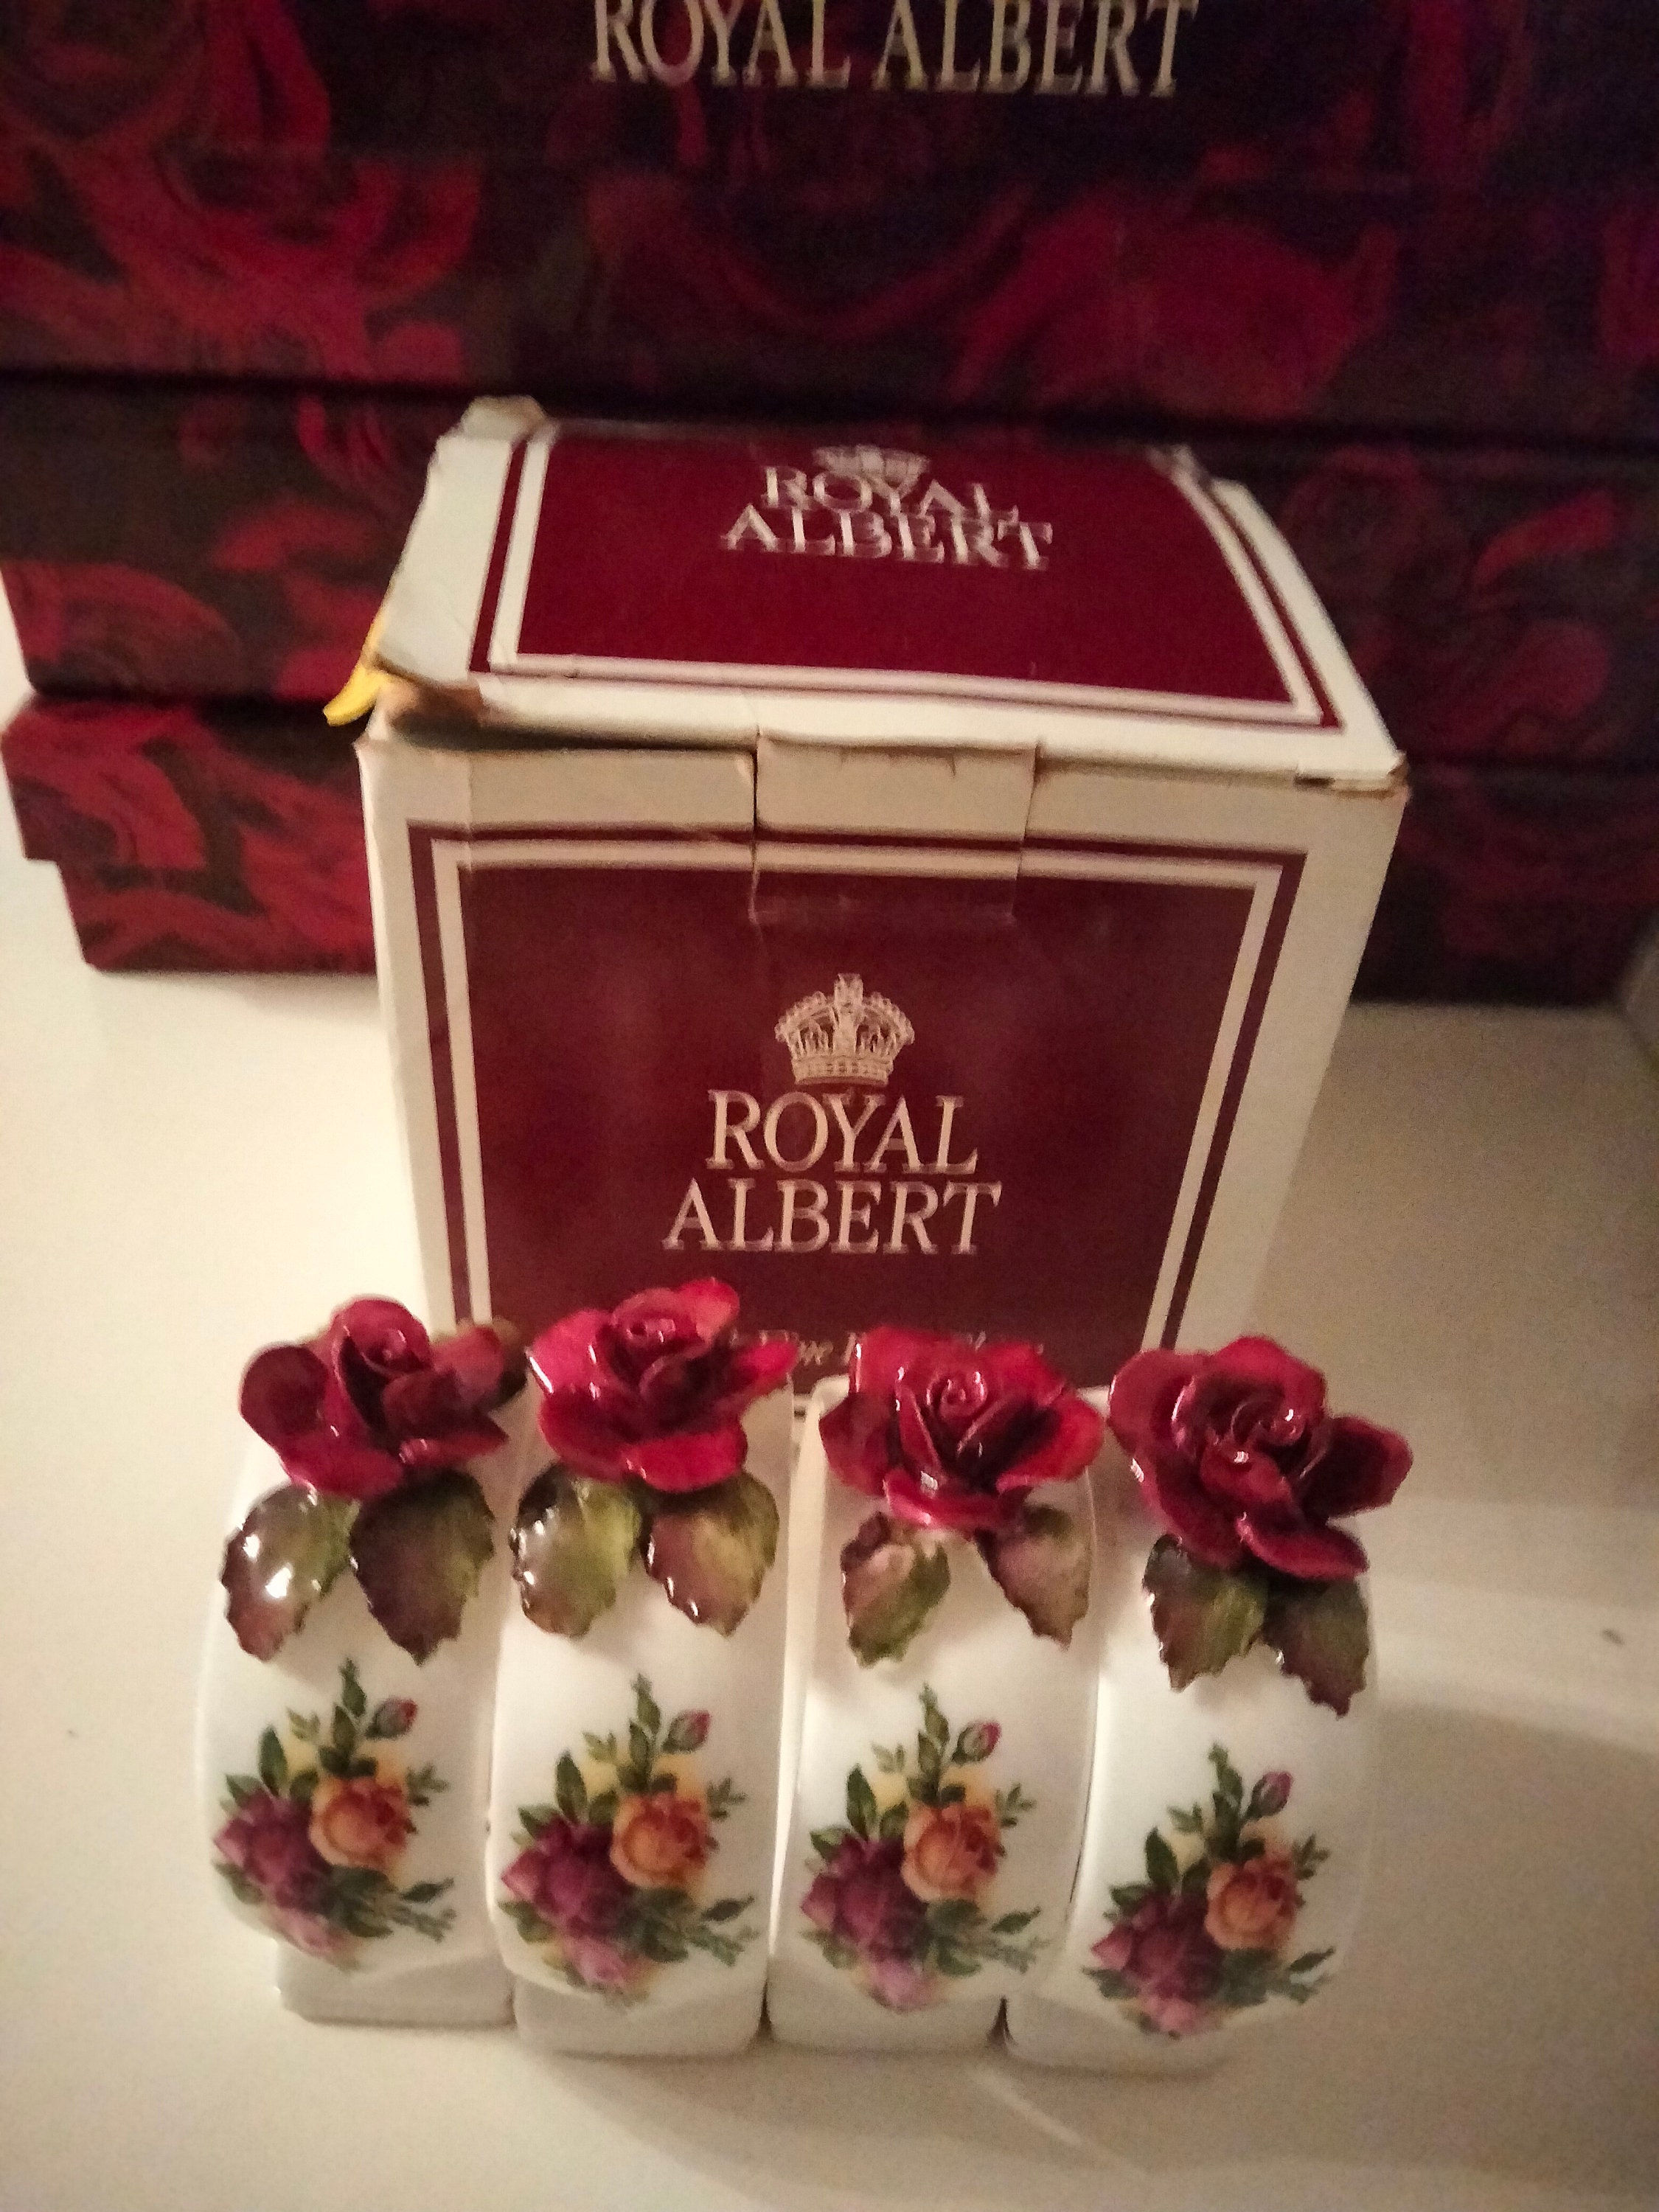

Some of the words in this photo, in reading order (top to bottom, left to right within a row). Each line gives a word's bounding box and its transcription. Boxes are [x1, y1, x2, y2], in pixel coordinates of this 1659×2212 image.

[591, 0, 852, 87] ROYAL
[871, 0, 1200, 98] ALBERT
[761, 465, 1019, 524] ROYAL
[721, 504, 1054, 571] ALBERT
[705, 1088, 979, 1175] ROYAL
[662, 1178, 1003, 1255] ALBERT
